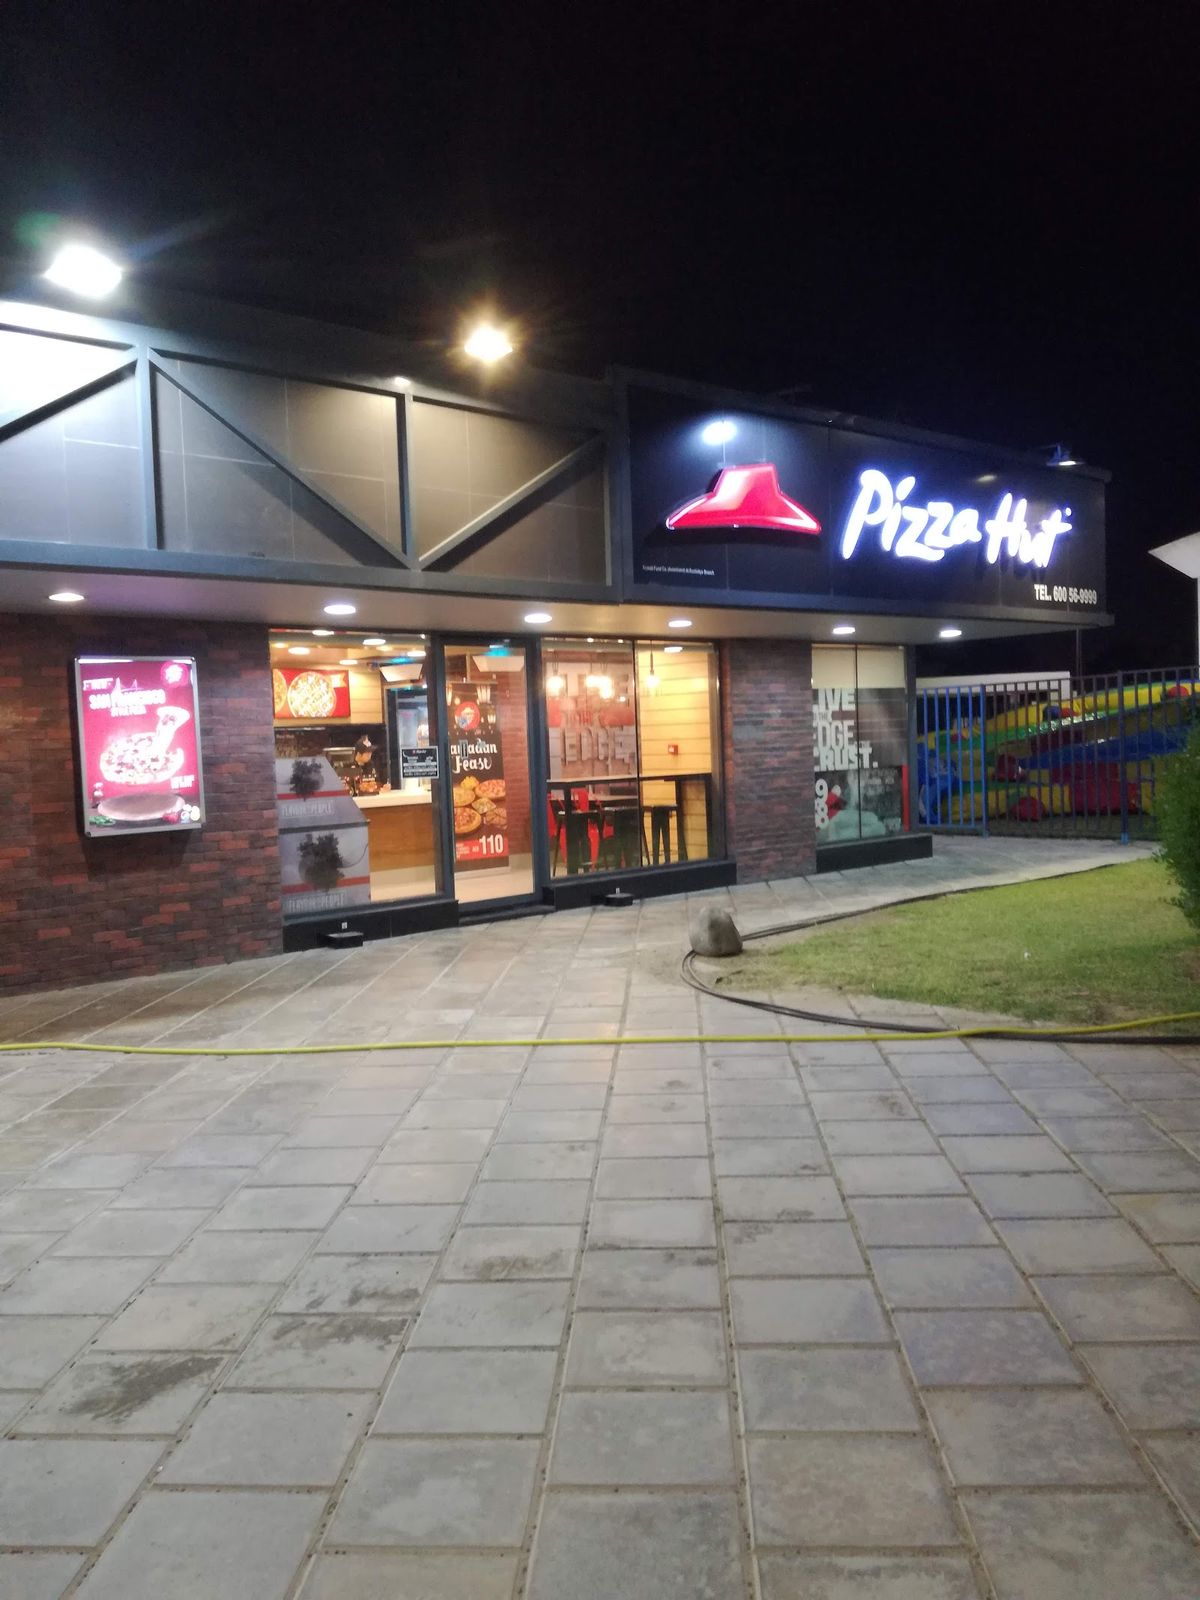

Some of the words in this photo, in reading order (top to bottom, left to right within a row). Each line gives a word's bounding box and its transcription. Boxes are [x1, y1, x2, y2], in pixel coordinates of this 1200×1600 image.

[842, 468, 983, 561] Pizza
[986, 492, 1073, 568] Hut
[1033, 583, 1052, 601] TEL.
[812, 688, 856, 712] IVE
[812, 720, 855, 748] DGE
[452, 755, 492, 774] Feast
[479, 833, 504, 855] 110
